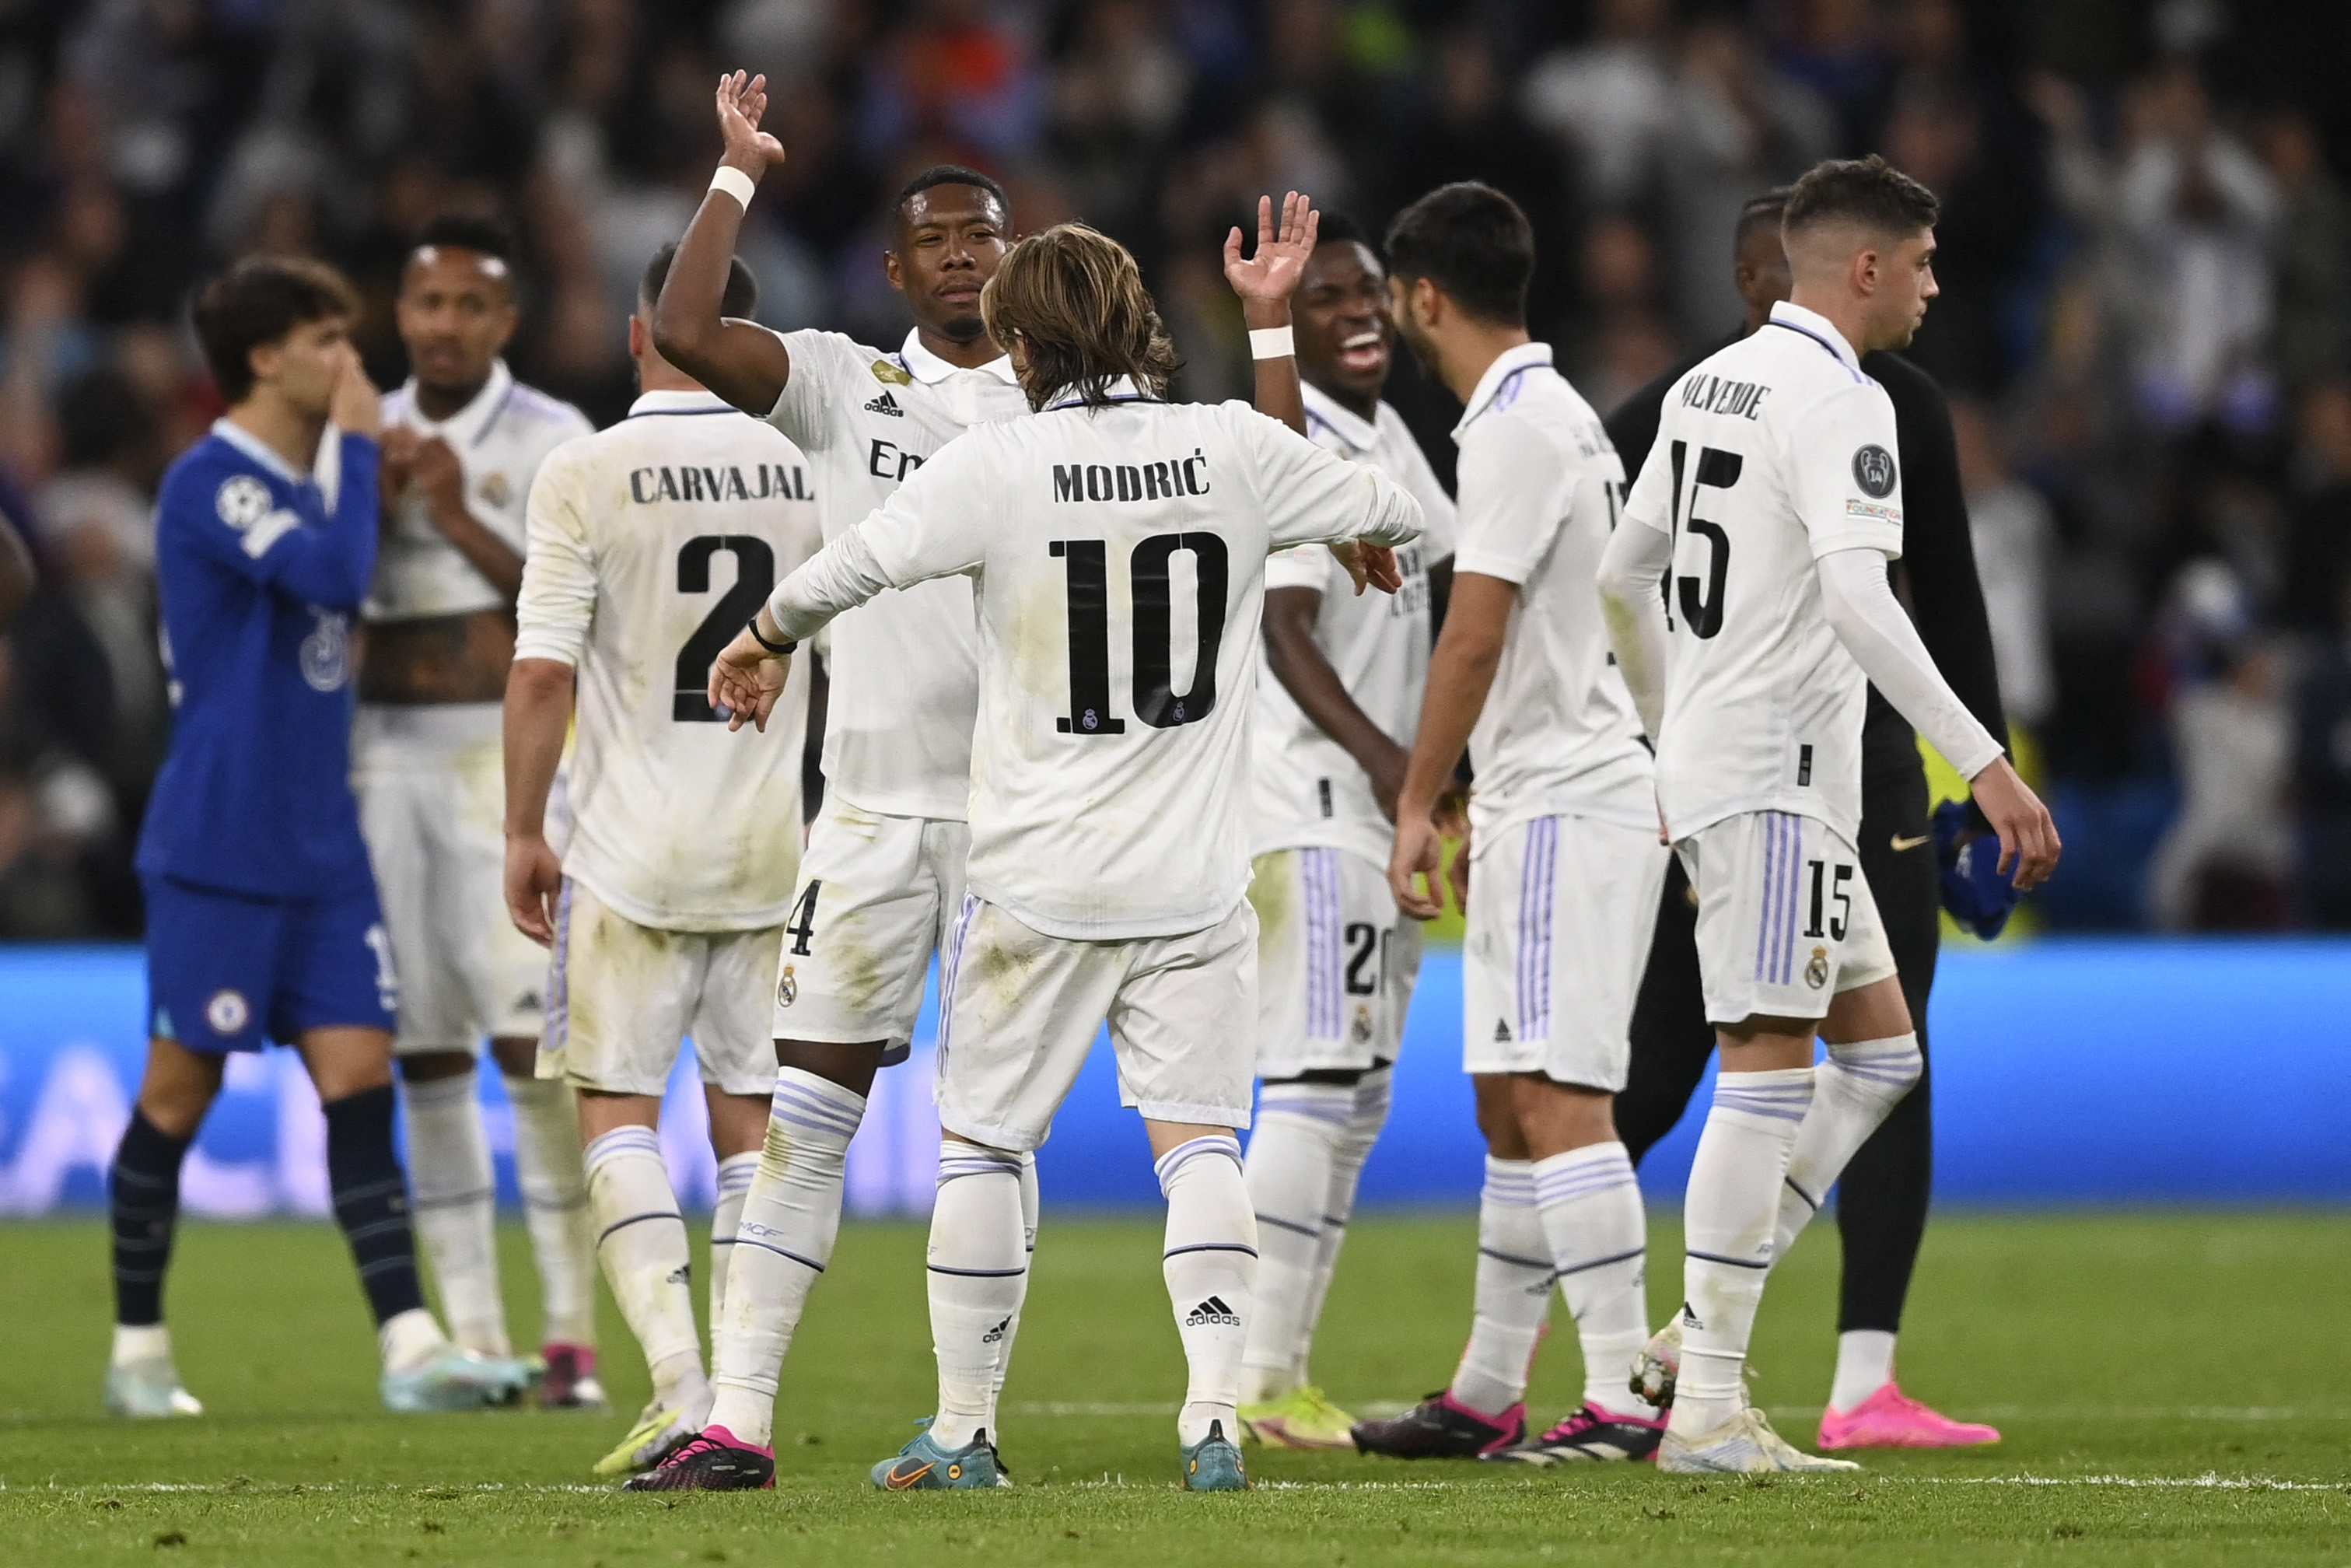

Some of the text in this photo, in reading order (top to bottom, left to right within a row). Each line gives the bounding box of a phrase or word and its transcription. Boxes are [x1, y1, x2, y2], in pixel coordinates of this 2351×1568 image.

[863, 402, 904, 418] adidas
[629, 464, 815, 505] CARVAJAL
[1052, 447, 1210, 503] MODRIĆ
[1661, 439, 1744, 639] 15
[672, 534, 775, 723] 2
[1048, 531, 1229, 735] 10
[785, 879, 823, 957] 4
[1803, 859, 1853, 942] 15
[1185, 1313, 1241, 1327] adidas
